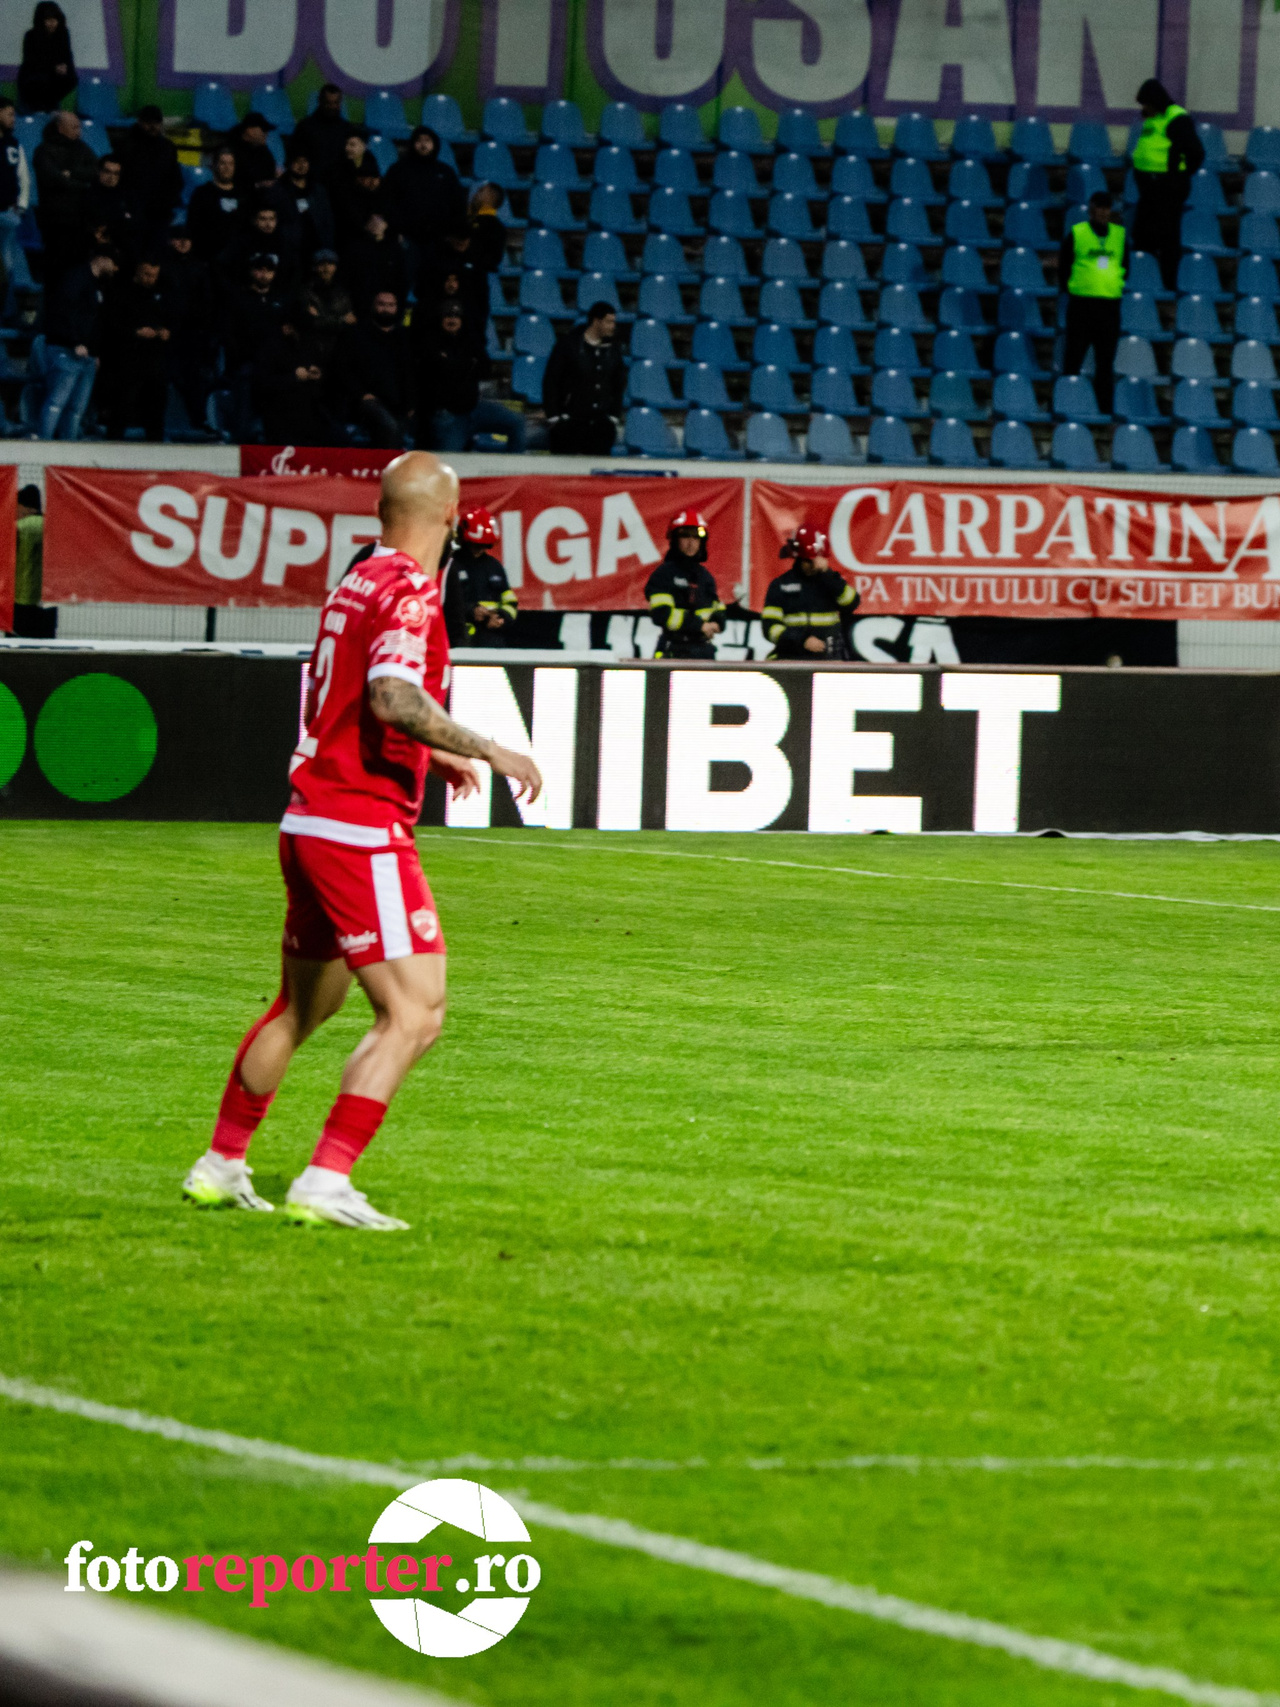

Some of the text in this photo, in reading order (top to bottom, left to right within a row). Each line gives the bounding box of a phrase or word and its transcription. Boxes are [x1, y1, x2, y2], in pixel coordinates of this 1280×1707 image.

[130, 484, 661, 590] SUPEIGA
[1066, 578, 1112, 605] CU
[1118, 579, 1226, 609] SUFLET
[299, 663, 1061, 833] NIBET
